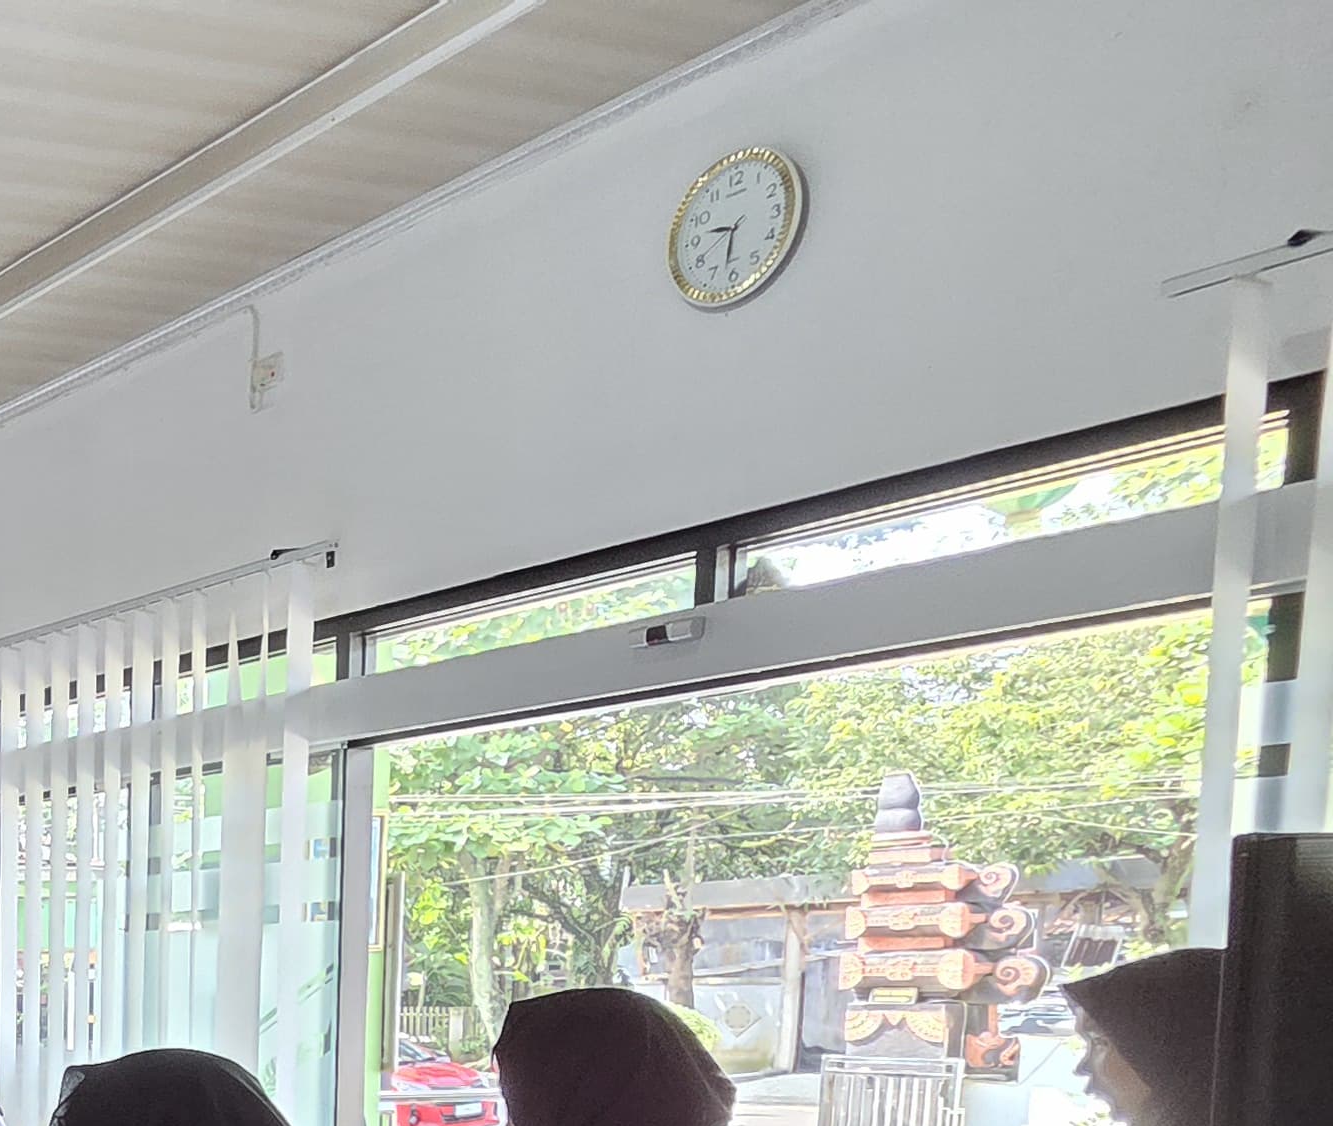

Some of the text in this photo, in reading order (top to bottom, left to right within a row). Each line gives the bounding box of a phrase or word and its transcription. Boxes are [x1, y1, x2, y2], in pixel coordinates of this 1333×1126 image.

[729, 170, 744, 188] 12
[757, 172, 761, 184] 1
[710, 189, 720, 203] 11
[766, 183, 777, 199] 2
[770, 204, 781, 219] 3
[693, 211, 711, 228] 10
[764, 228, 775, 241] 4
[691, 235, 701, 250] 9
[695, 254, 705, 269] 8
[750, 250, 760, 265] 5
[708, 265, 718, 280] 7
[728, 267, 739, 282] 6
